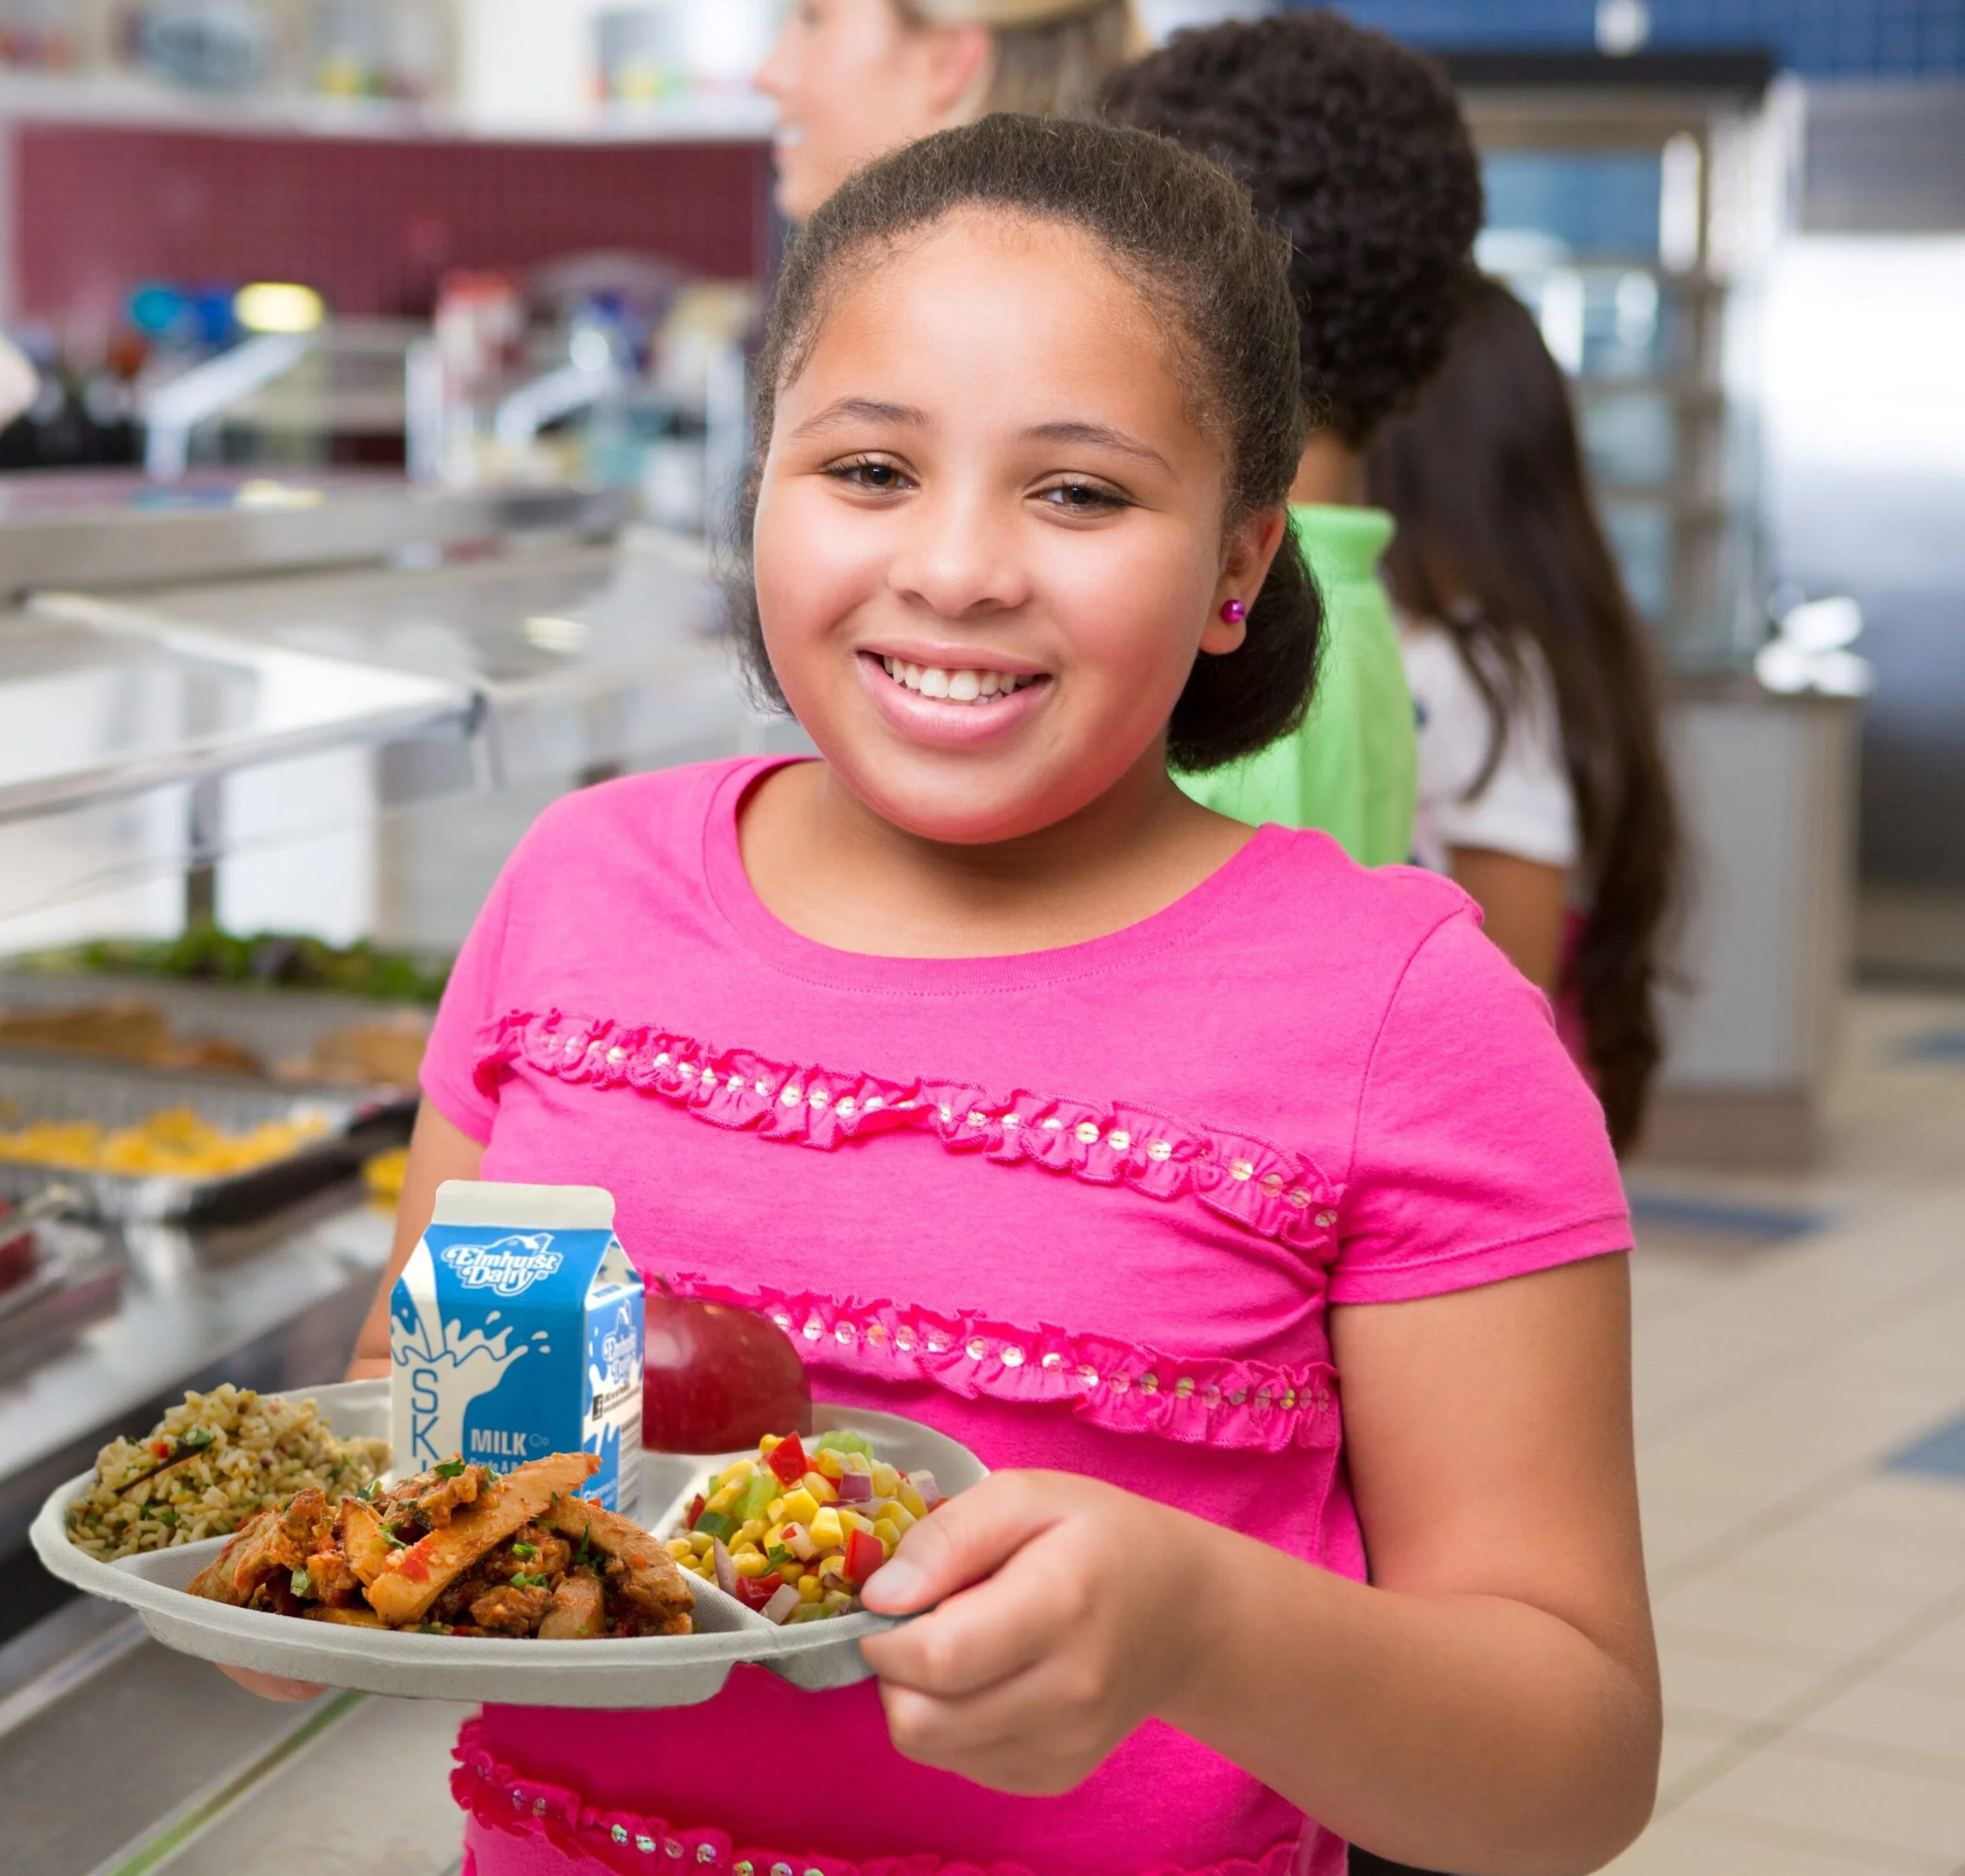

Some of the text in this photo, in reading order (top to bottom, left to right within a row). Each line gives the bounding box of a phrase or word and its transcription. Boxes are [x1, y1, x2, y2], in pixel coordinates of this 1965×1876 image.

[461, 1265, 534, 1293] Dairy
[411, 1368, 440, 1473] SK
[470, 1428, 528, 1457] MILK
